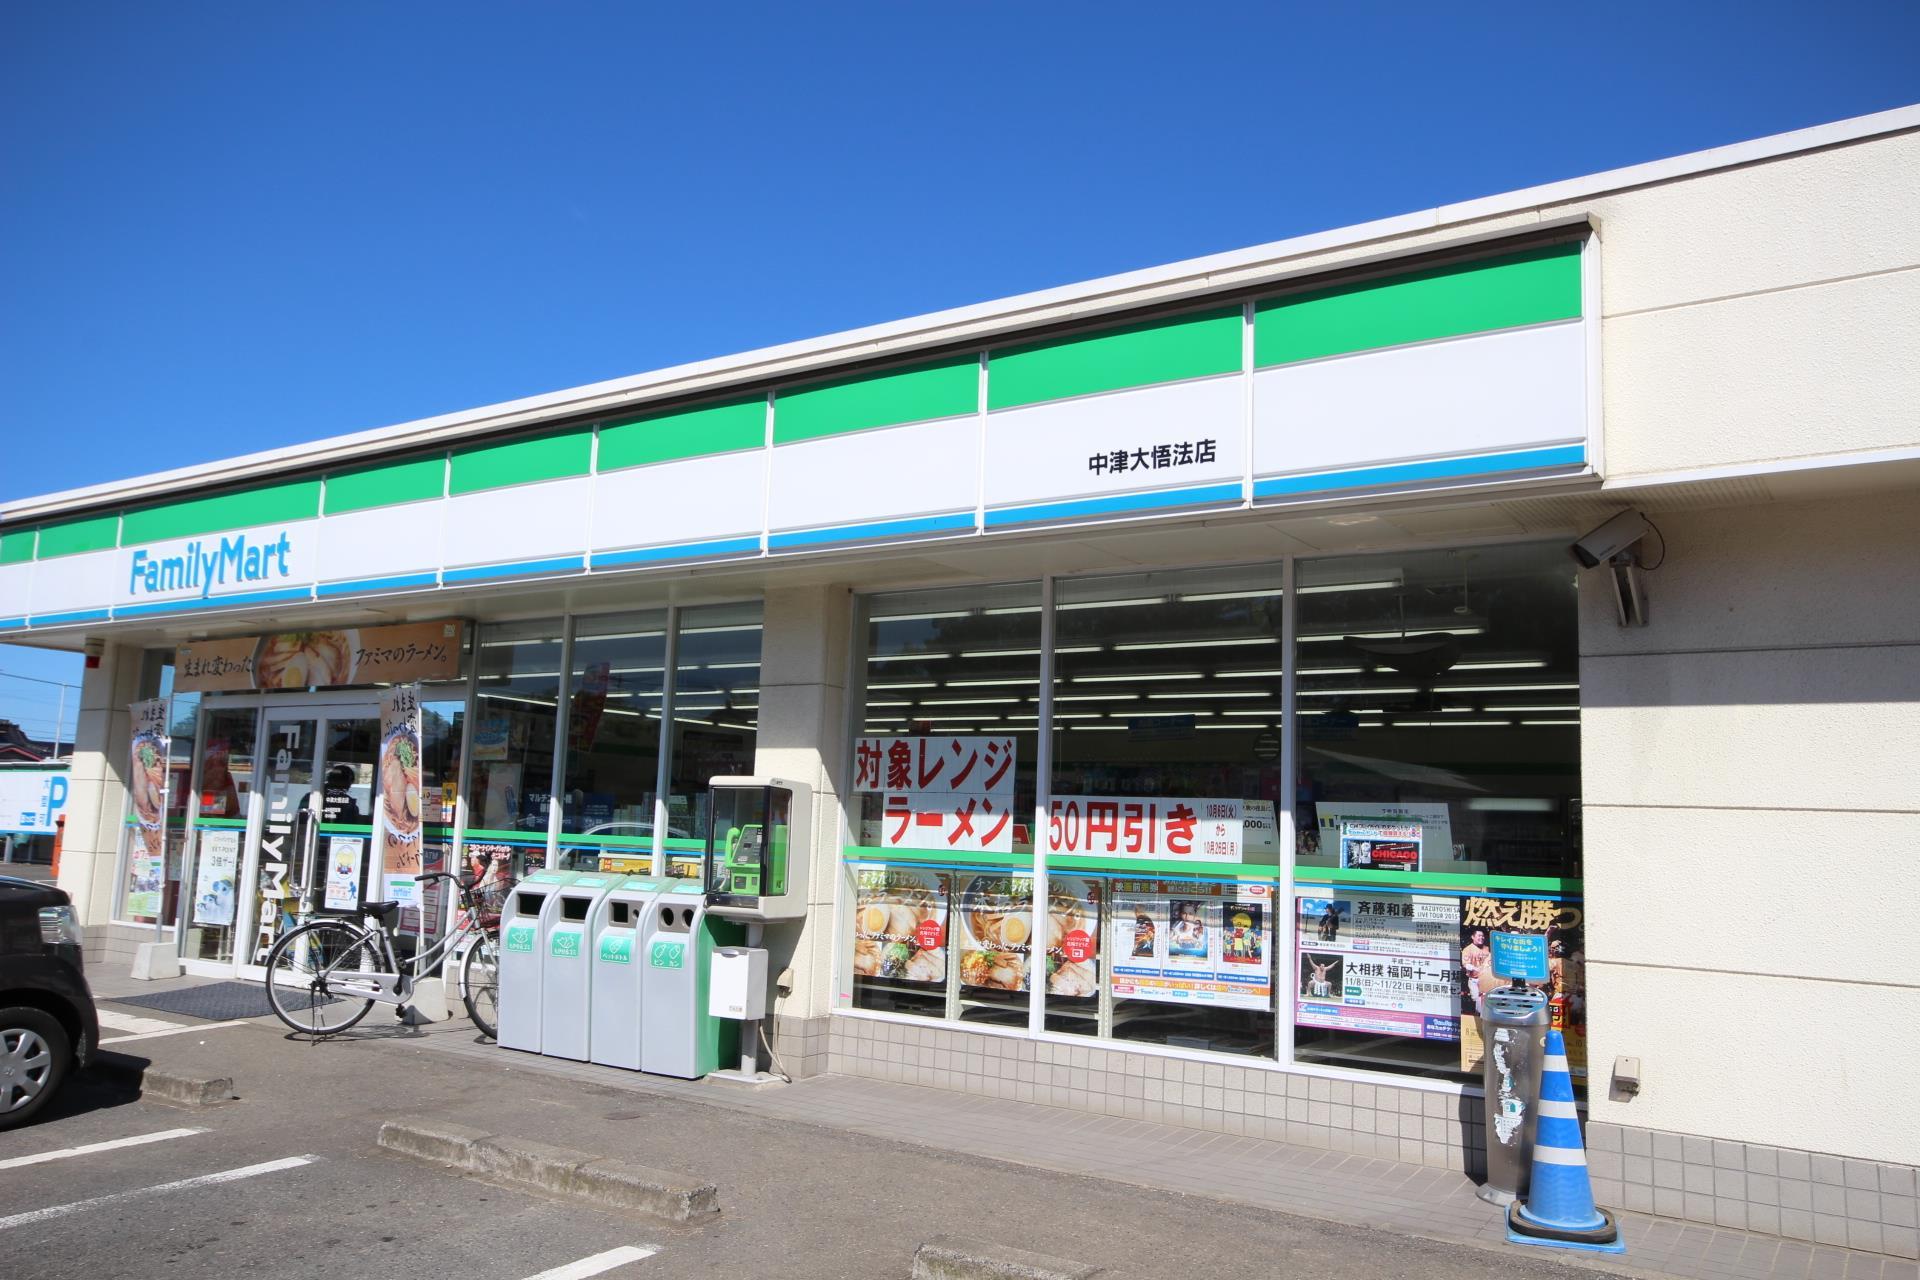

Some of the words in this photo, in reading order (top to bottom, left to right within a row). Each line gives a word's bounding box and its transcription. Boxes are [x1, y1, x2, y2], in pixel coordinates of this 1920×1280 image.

[1089, 438, 1217, 476] 中津大悟法店
[129, 531, 291, 599] FamilyMart
[856, 738, 1012, 791] 対象レンジ
[46, 776, 68, 827] P
[885, 797, 1010, 847] ラーメン
[255, 725, 301, 963] FamilyMart
[1050, 800, 1198, 855] 50円引き
[1215, 823, 1226, 837] から
[1372, 849, 1418, 859] CHICAGO
[1358, 901, 1415, 918] 斉藤和義
[1345, 962, 1384, 977] 大相撲
[1391, 957, 1431, 967] 平成二十七年
